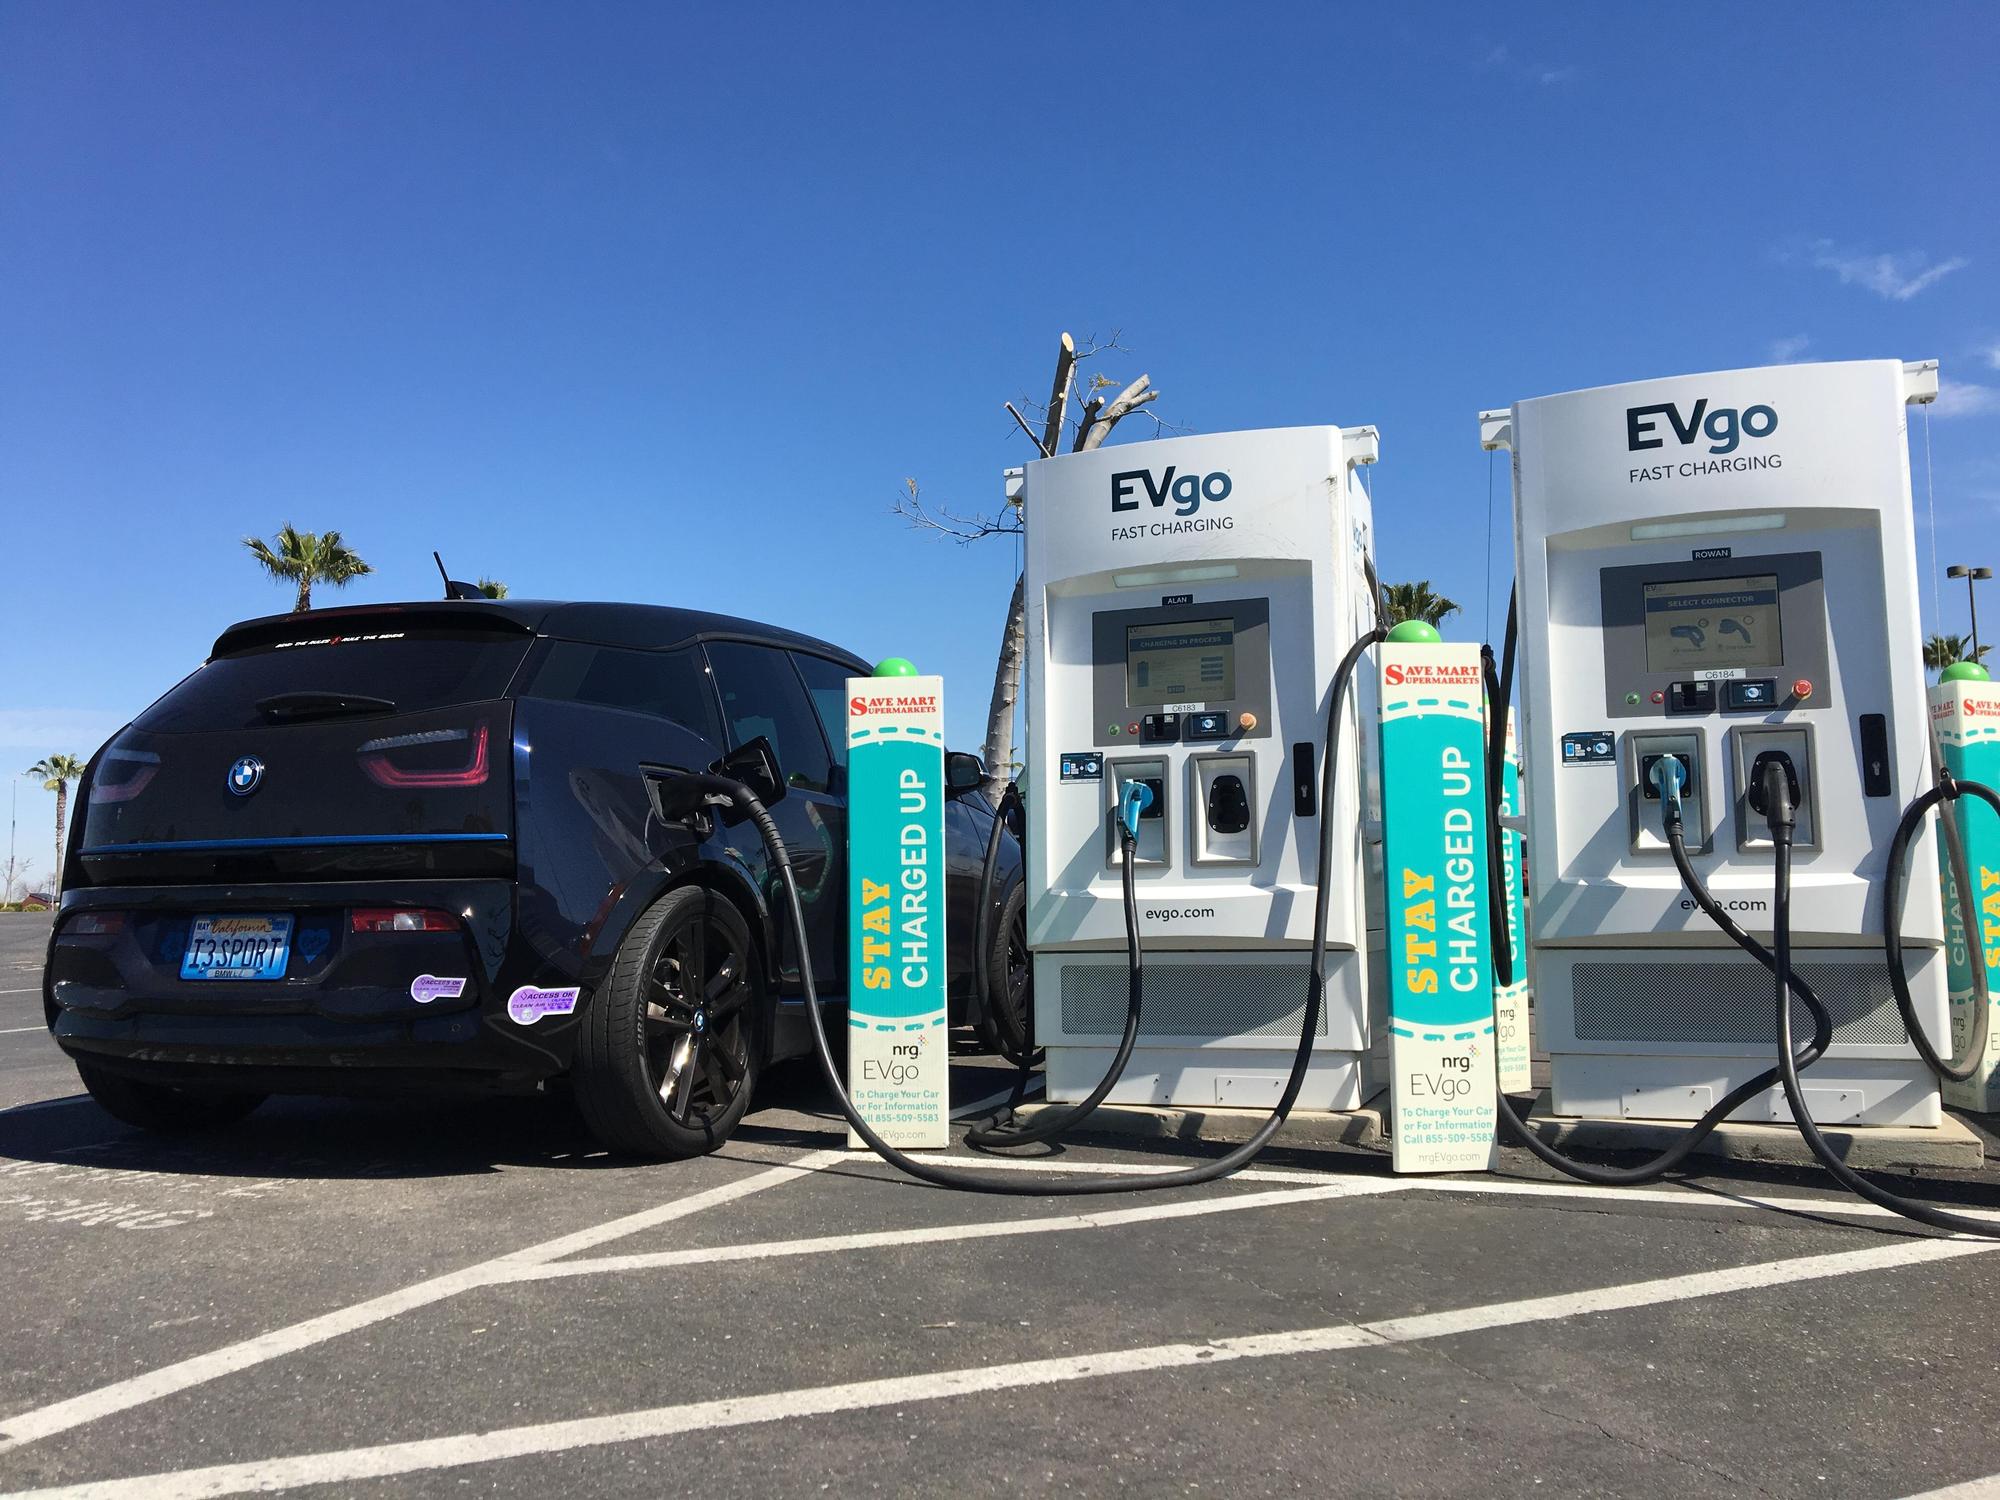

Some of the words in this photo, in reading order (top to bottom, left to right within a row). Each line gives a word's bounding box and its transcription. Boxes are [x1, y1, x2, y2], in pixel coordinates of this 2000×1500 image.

[1627, 398, 1779, 455] EVgo
[1629, 465, 1674, 483] FAST
[1679, 454, 1782, 477] CHARGING
[1111, 466, 1232, 516] EVgo
[1112, 525, 1147, 541] FAST
[1150, 516, 1234, 537] CHARGING
[1695, 549, 1729, 559] ROWAN
[1167, 596, 1188, 605] ALAN
[1667, 599, 1698, 608] SELECT
[1701, 595, 1754, 606] CONNECTOR
[1140, 639, 1178, 649] CHARGING
[1179, 638, 1188, 646] IN
[1189, 635, 1222, 645] PROCESS
[1436, 666, 1479, 676] MART
[1704, 670, 1735, 680] C6184
[896, 696, 936, 706] MART
[1172, 703, 1196, 713] C6183
[1442, 746, 1472, 796] UP
[900, 768, 927, 814] UP
[901, 824, 928, 988] CHARGED
[1444, 808, 1479, 992] CHARGED
[1680, 899, 1767, 914] evo.com
[1145, 908, 1215, 922] evgo.com
[1980, 865, 2000, 968] STAY
[196, 920, 211, 931] MAY
[210, 919, 273, 937] California
[862, 878, 891, 989] STAY
[1403, 868, 1438, 994] STAY
[188, 937, 283, 969] I3SPORT
[527, 992, 560, 1000] ACCESS
[1500, 1009, 1515, 1021] nrg
[1953, 1017, 1965, 1031] nrg
[1497, 1023, 1516, 1042] go
[892, 1045, 919, 1060] nrg
[1442, 1056, 1470, 1072] nrg
[863, 1060, 919, 1085] EVgo
[1410, 1074, 1471, 1102] EVgo
[855, 1091, 865, 1099] To
[867, 1090, 898, 1101] Charge
[900, 1090, 920, 1098] Your
[923, 1090, 939, 1098] Car
[885, 1102, 938, 1110] Information
[1403, 1108, 1412, 1117] To
[1415, 1107, 1450, 1118] Charge
[1452, 1107, 1473, 1116] Your
[1476, 1106, 1494, 1116] Car
[860, 1114, 873, 1122] all
[875, 1114, 939, 1122] 855-509-5583
[1404, 1122, 1414, 1130] or
[1417, 1121, 1432, 1130] For
[1435, 1121, 1492, 1130] Information
[875, 1130, 926, 1141] rgEVgo.com
[1404, 1135, 1423, 1144] Call
[1426, 1133, 1493, 1144] 855-509-5583
[1418, 1152, 1481, 1165] nrgEVgo.com
